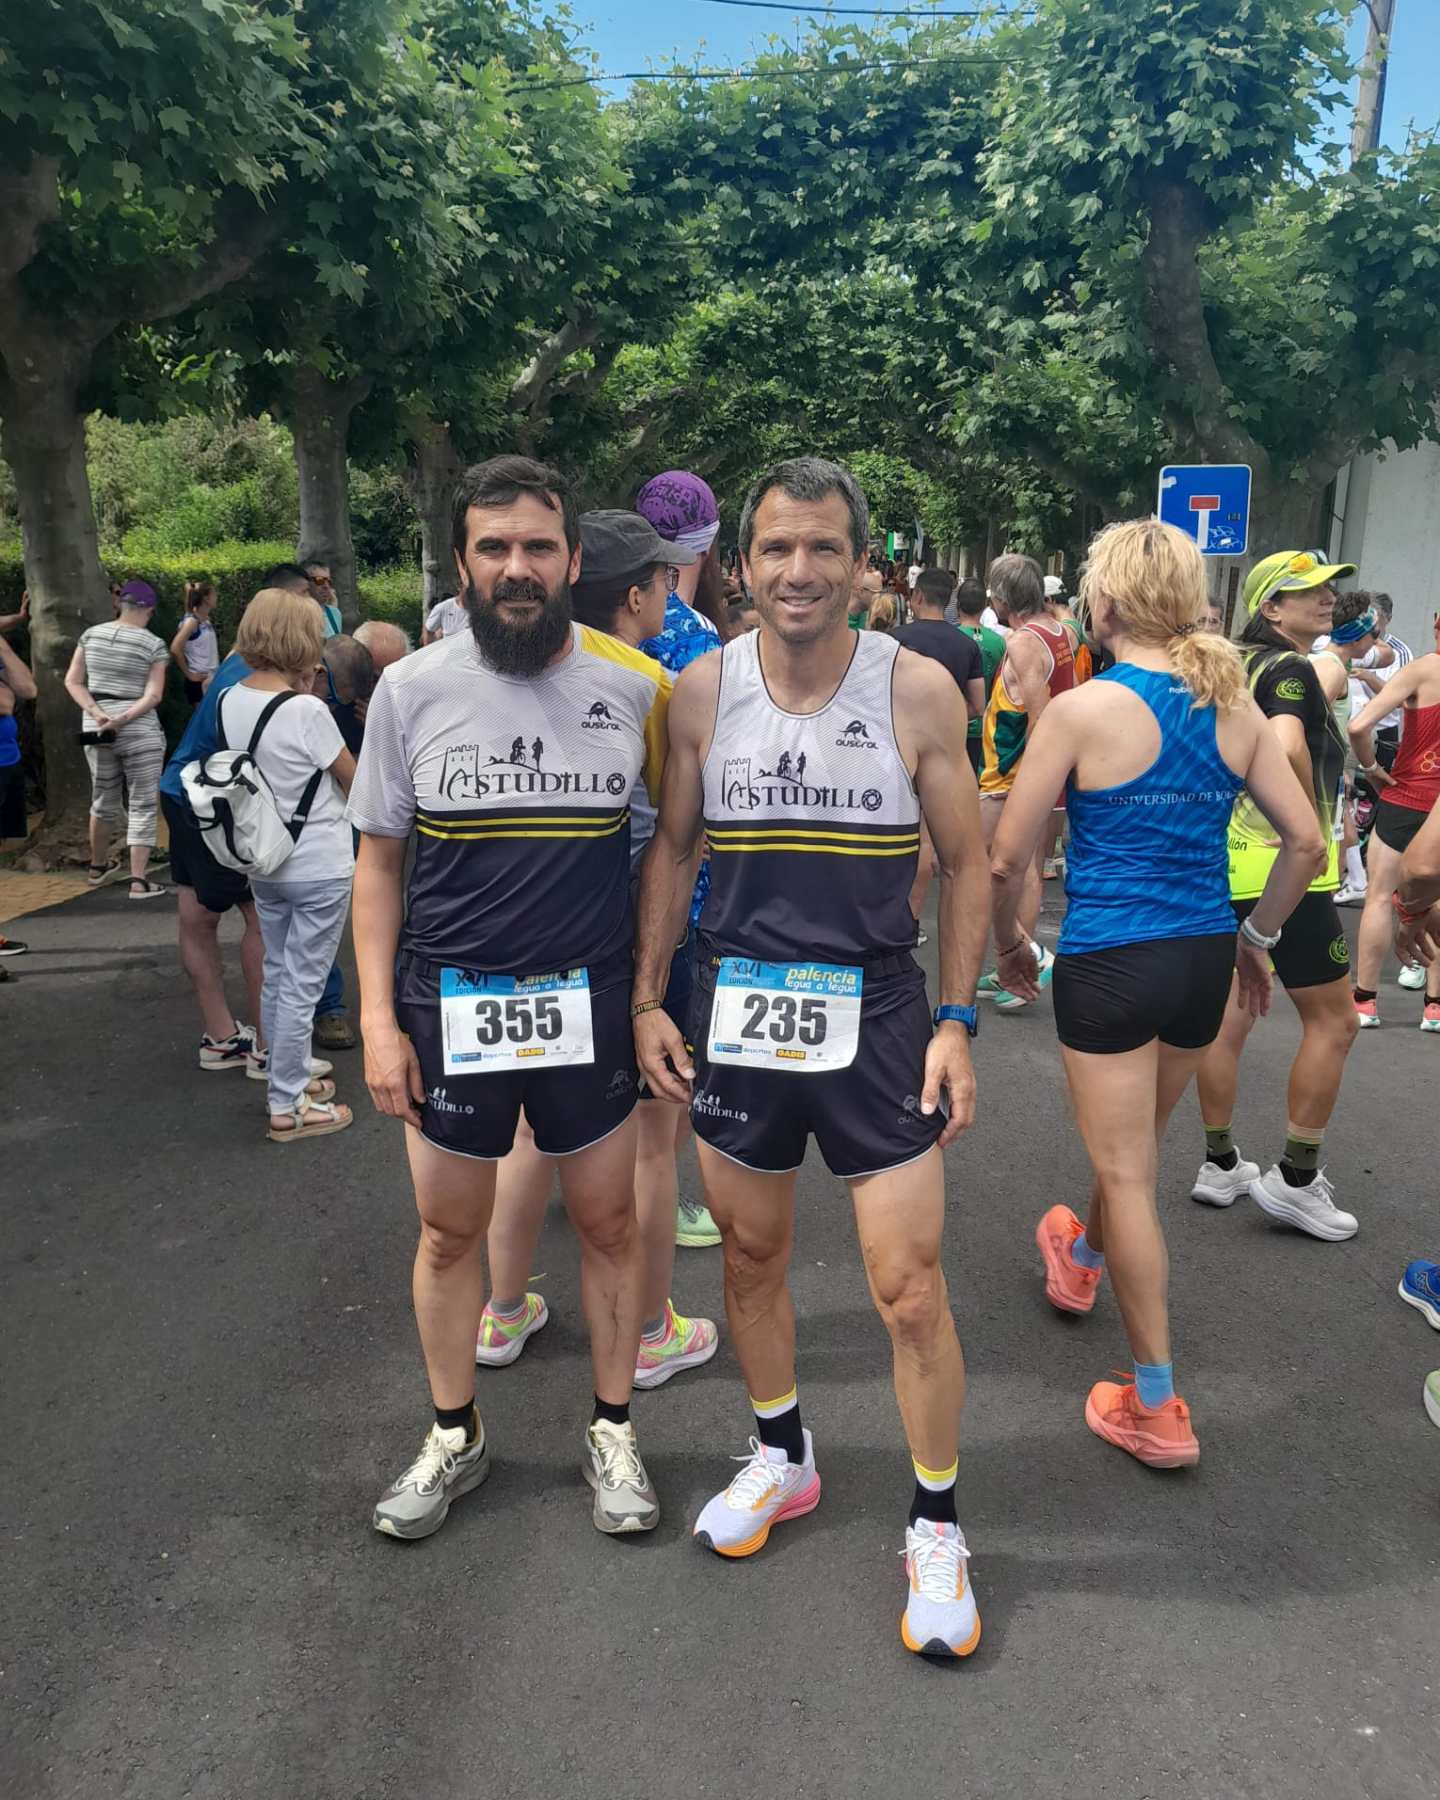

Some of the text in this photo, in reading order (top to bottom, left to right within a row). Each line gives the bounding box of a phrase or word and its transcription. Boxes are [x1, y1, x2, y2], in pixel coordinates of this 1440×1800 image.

[581, 720, 621, 731] austral
[836, 739, 879, 750] austral
[1108, 792, 1196, 806] UNIVERSIDAD
[1198, 791, 1213, 802] DE
[732, 960, 761, 978] XVI
[787, 966, 857, 985] palencia
[785, 979, 812, 992] legua
[828, 983, 856, 994] legua
[475, 996, 563, 1045] 355
[740, 993, 827, 1046] 235
